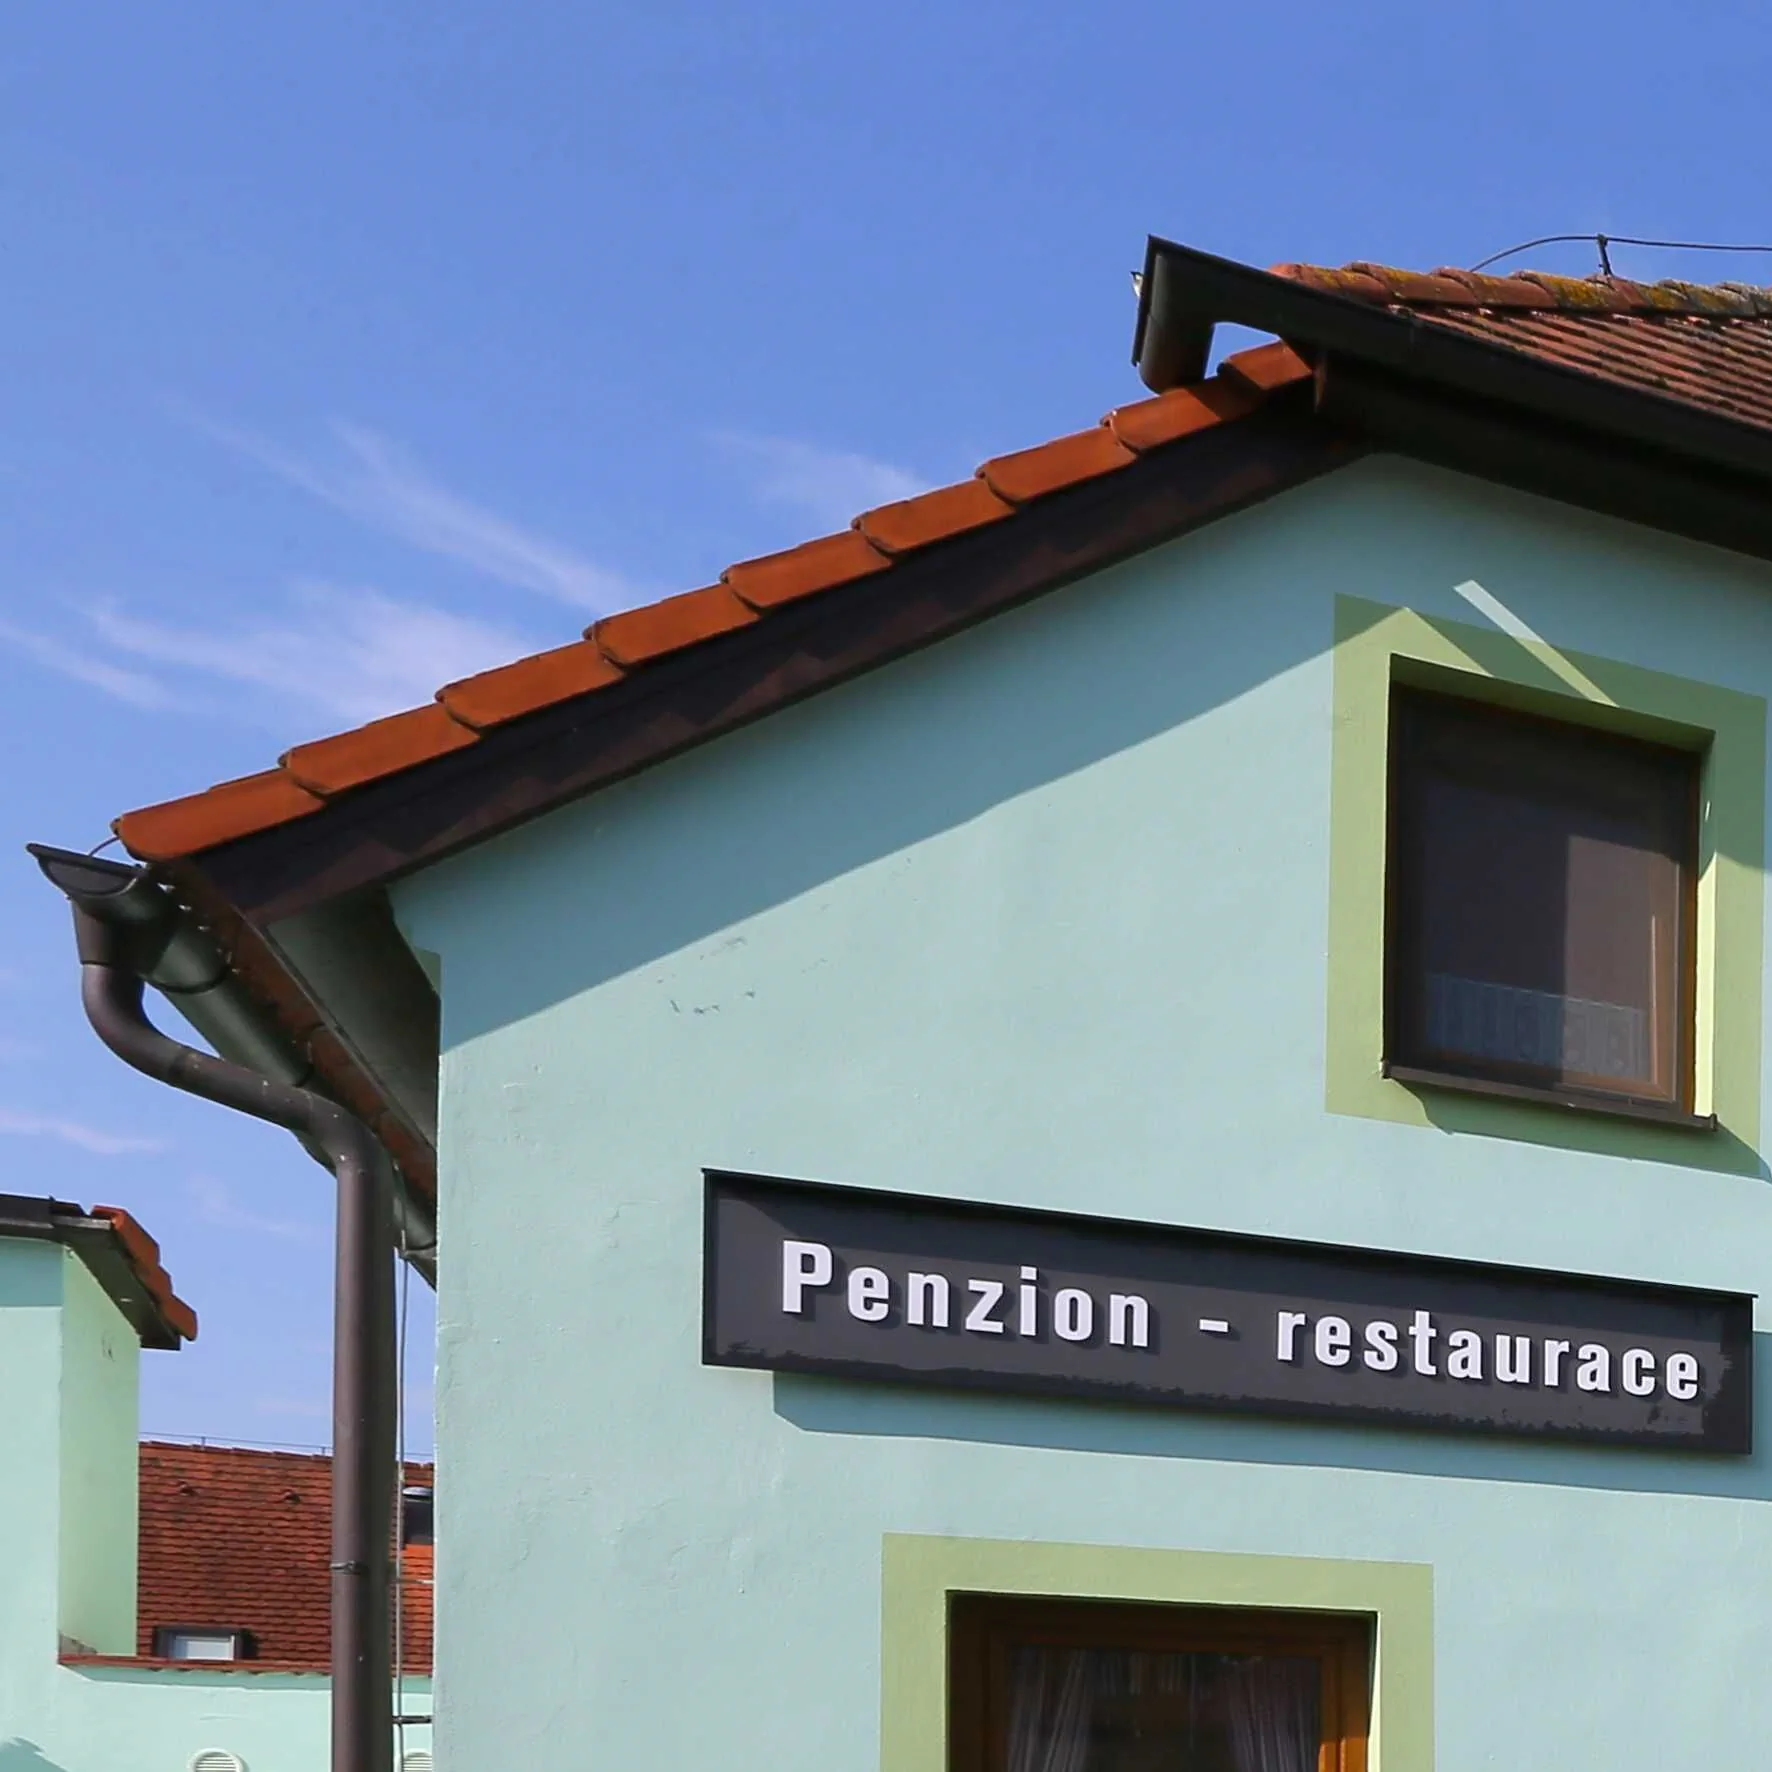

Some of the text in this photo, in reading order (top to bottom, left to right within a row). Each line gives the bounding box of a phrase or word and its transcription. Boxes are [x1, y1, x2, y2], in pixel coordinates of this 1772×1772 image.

[781, 1238, 1699, 1401] Penzion - restaurace
